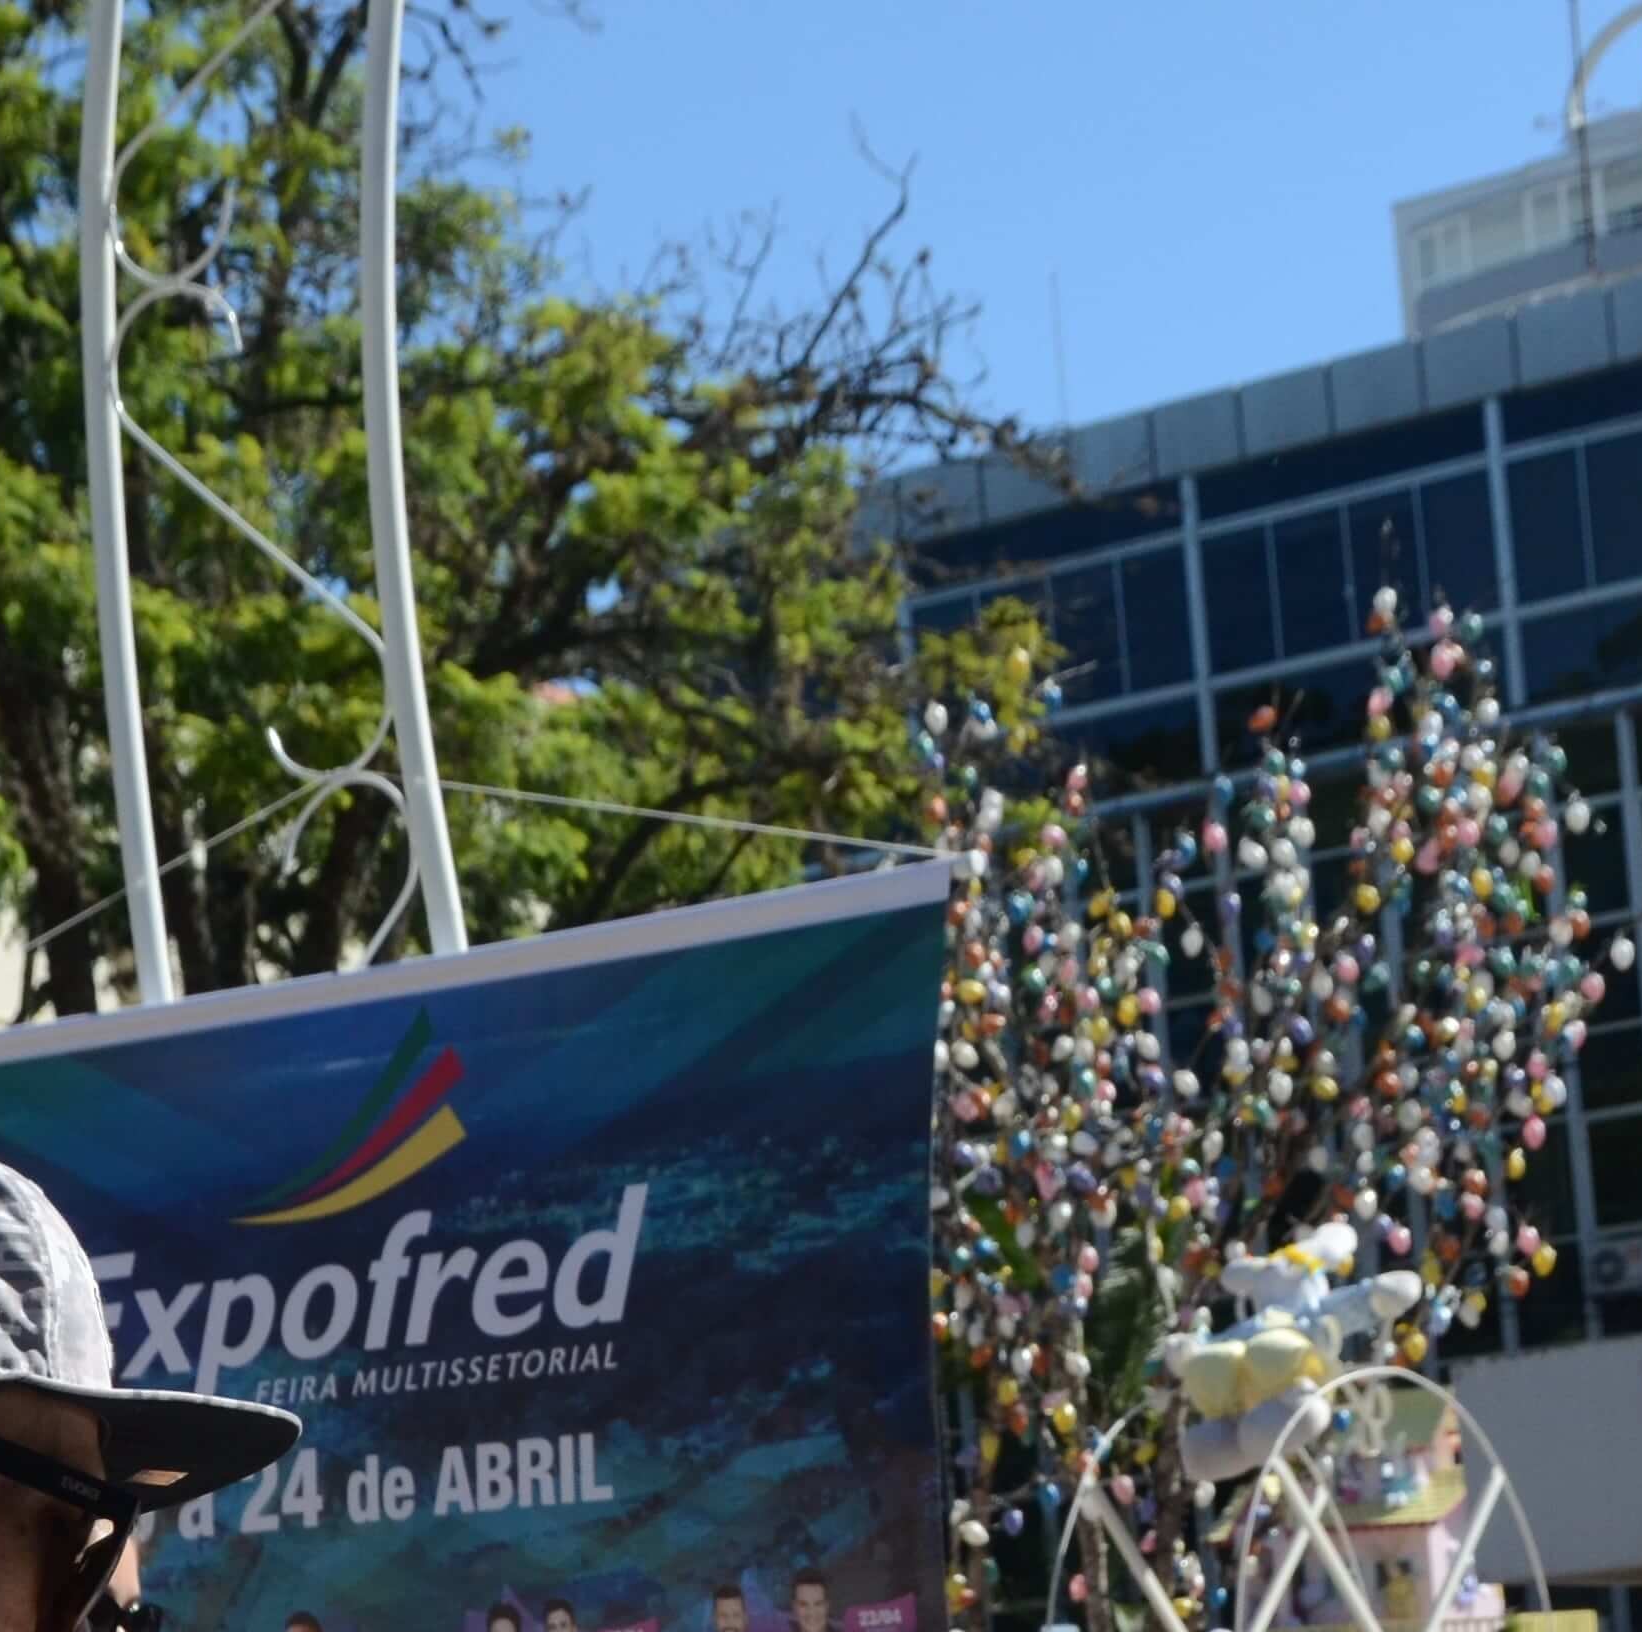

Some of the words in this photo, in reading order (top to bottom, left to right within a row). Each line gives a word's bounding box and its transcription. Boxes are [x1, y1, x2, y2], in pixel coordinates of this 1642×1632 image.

[257, 1371, 338, 1404] FEIRA
[352, 1341, 618, 1397] MULTISSETORIAL
[240, 1447, 323, 1534] 24
[347, 1455, 414, 1522] de
[434, 1433, 613, 1516] ABRIL
